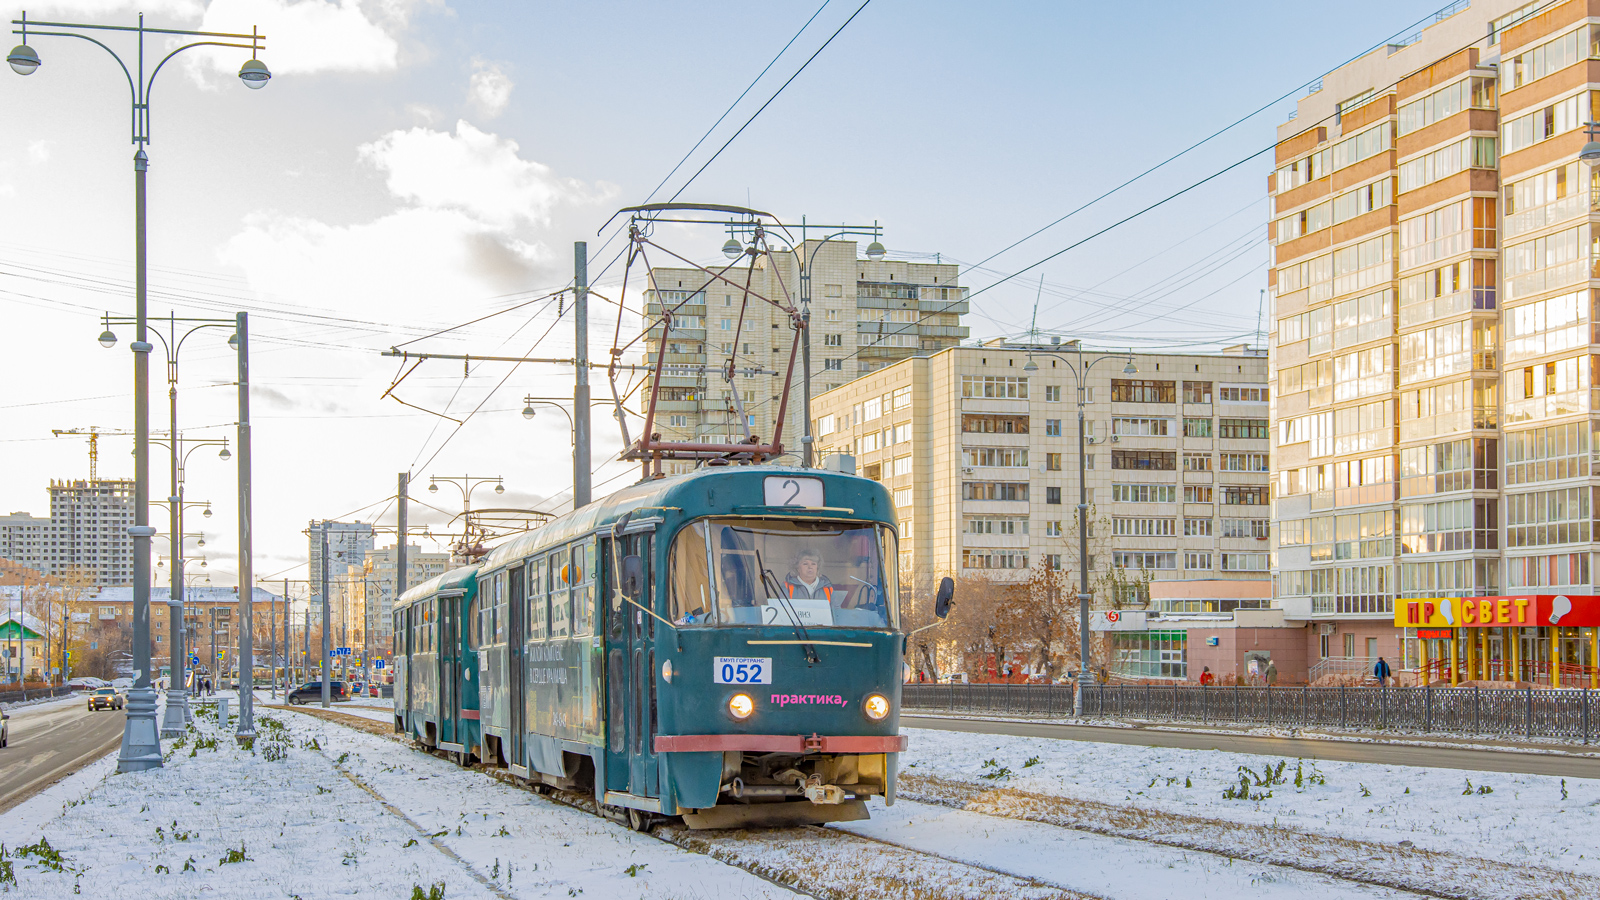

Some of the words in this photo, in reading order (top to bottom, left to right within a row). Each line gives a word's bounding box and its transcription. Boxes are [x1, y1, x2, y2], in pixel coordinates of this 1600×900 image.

[783, 480, 800, 506] 2
[765, 606, 778, 625] 2
[721, 663, 763, 683] 052
